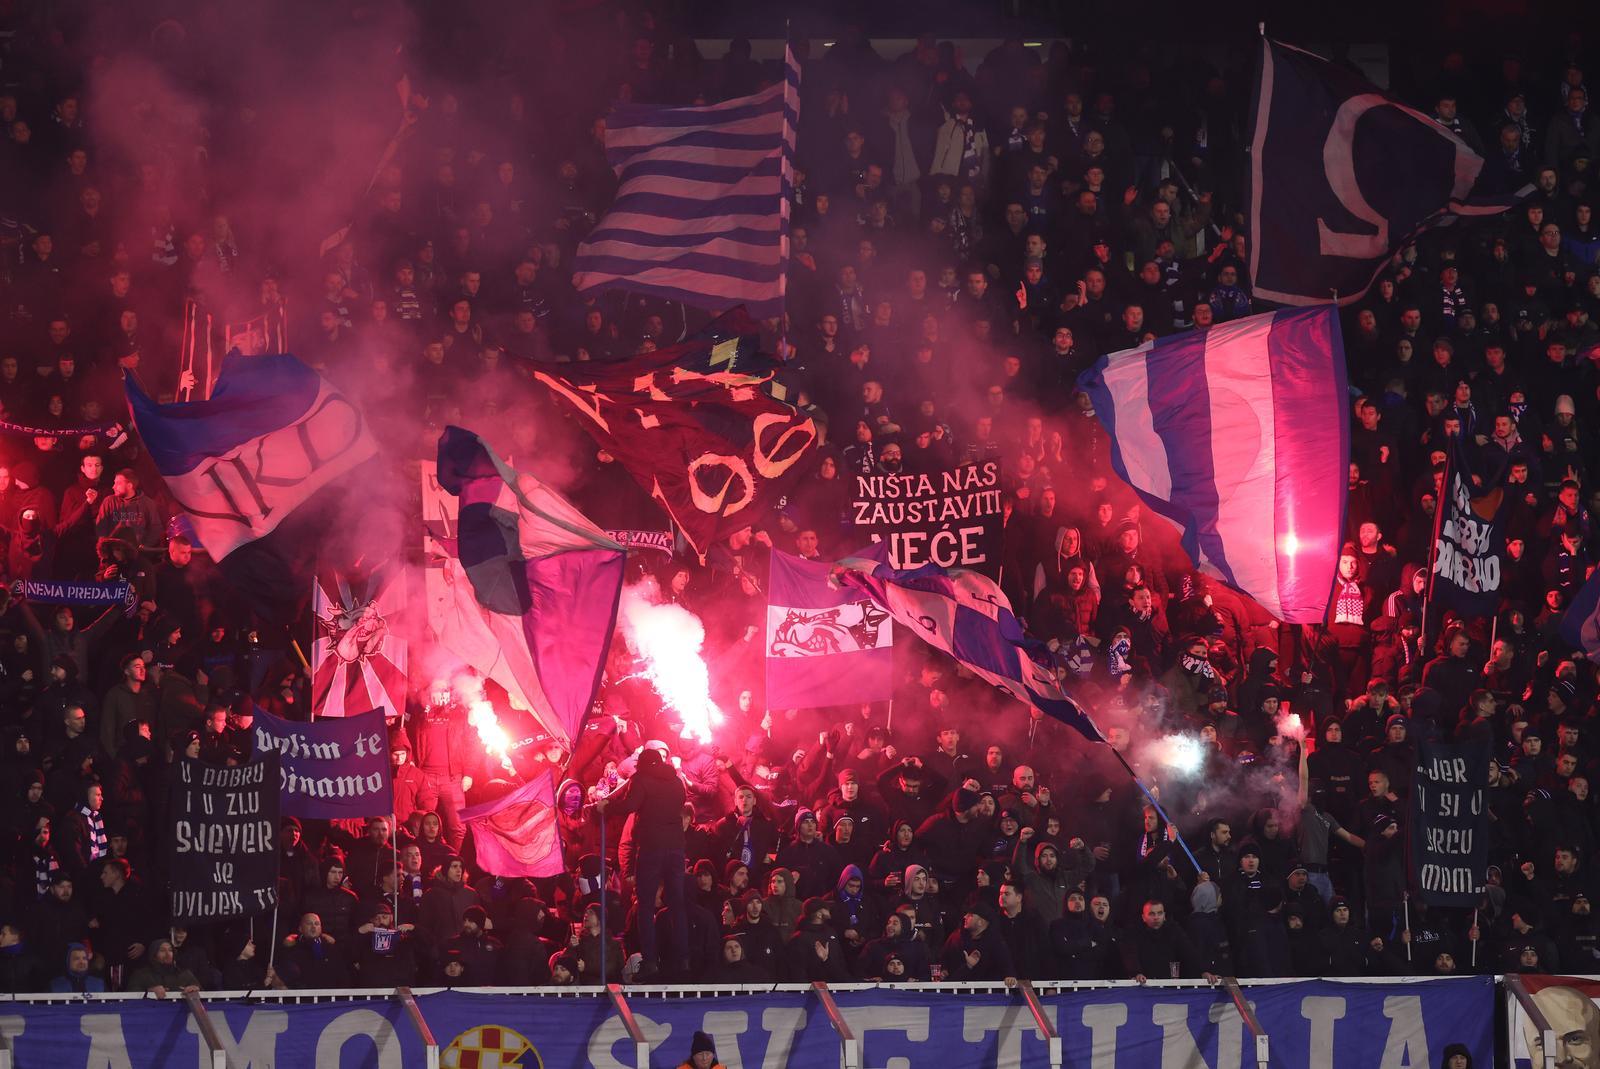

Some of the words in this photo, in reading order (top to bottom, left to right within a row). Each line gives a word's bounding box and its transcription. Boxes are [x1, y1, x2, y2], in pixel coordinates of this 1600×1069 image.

[856, 472, 936, 498] NIŠTA
[942, 462, 998, 493] NAS
[852, 490, 1002, 525] ZAUSTAVITI
[27, 582, 65, 598] NEMA
[67, 586, 126, 600] PREDAJE
[354, 732, 382, 758] te
[180, 761, 192, 783] U
[202, 762, 264, 787] DOBRU
[186, 791, 192, 812] I
[203, 793, 214, 815] U
[226, 791, 260, 816] ZLU
[1438, 792, 1460, 817] SI
